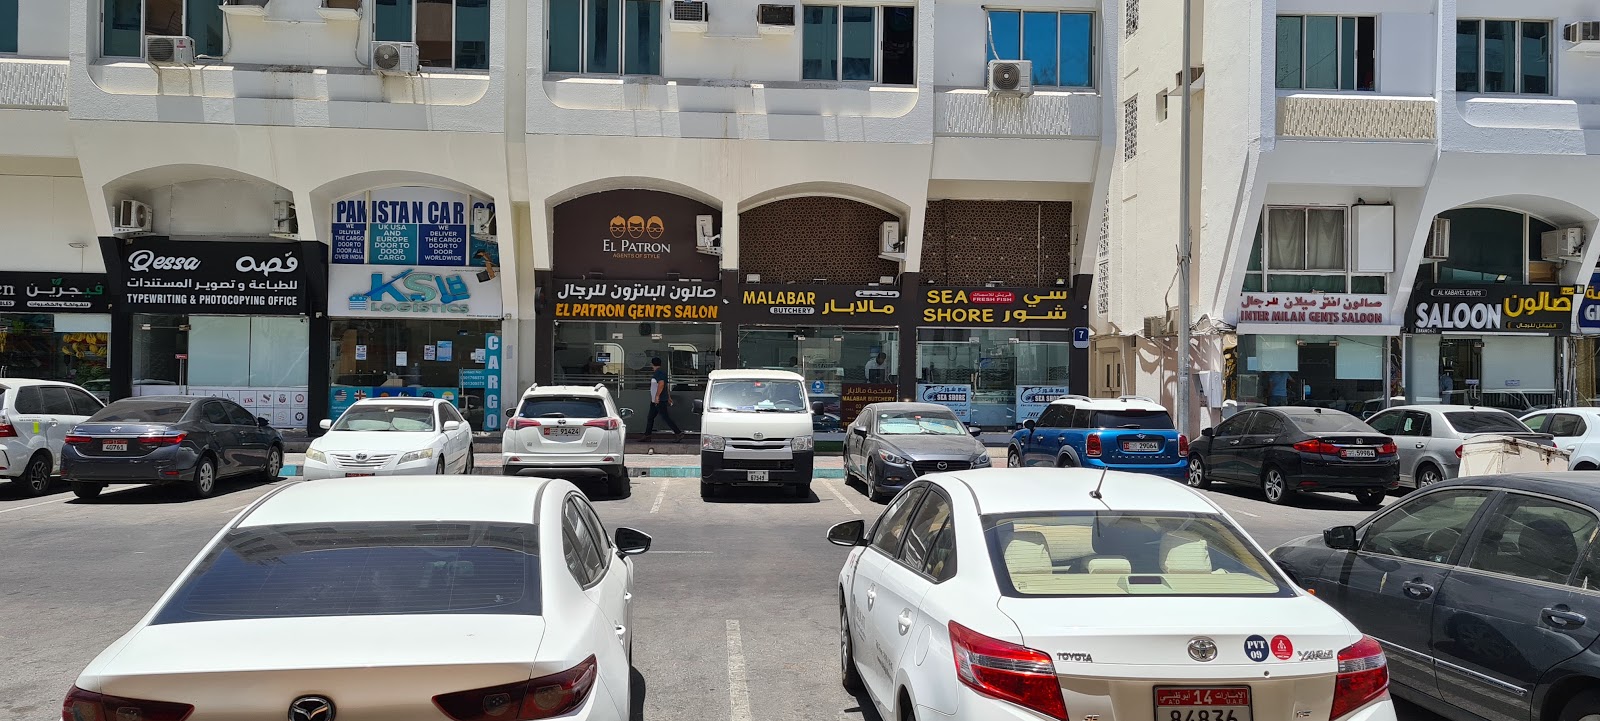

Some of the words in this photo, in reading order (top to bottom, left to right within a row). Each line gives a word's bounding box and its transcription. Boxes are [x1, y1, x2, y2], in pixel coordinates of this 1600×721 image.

[127, 250, 201, 273] Qessa
[127, 278, 192, 288] المستندات
[194, 279, 236, 291] تصوير
[248, 280, 298, 292] للطباعة
[557, 284, 607, 300] للرجال
[669, 285, 716, 302] صالون
[743, 291, 816, 305] MALABAR
[927, 289, 969, 304] SEA
[1023, 290, 1067, 308] سي
[127, 293, 187, 304] TYPEWRITING
[189, 294, 197, 304] &
[199, 295, 265, 305] PHOTOCOPYING
[267, 296, 298, 306] OFFICE
[1283, 296, 1317, 310] ميلان
[1342, 297, 1383, 311] صالون
[1503, 291, 1572, 318] صالون
[370, 302, 471, 314] LOGISTICS
[555, 303, 571, 317] EL
[572, 303, 625, 318] PATRON
[627, 304, 672, 319] GENTS
[674, 305, 719, 319] SALON
[821, 299, 895, 315] مالابار
[1002, 304, 1067, 323] شور
[923, 308, 994, 323] SHORE
[1240, 310, 1270, 322] INTER
[1271, 310, 1306, 322] MILAN
[1308, 311, 1340, 323] GENTS
[1341, 312, 1383, 324] SALOON
[1415, 302, 1502, 329] SALOON
[1078, 330, 1084, 339] 7
[486, 335, 499, 429] CARGO
[936, 393, 948, 401] SEA
[947, 393, 966, 401] SHORE
[1246, 640, 1265, 649] PVT
[1056, 652, 1093, 663] TOYOTA
[1250, 650, 1263, 659] 09
[1193, 689, 1213, 705] 14
